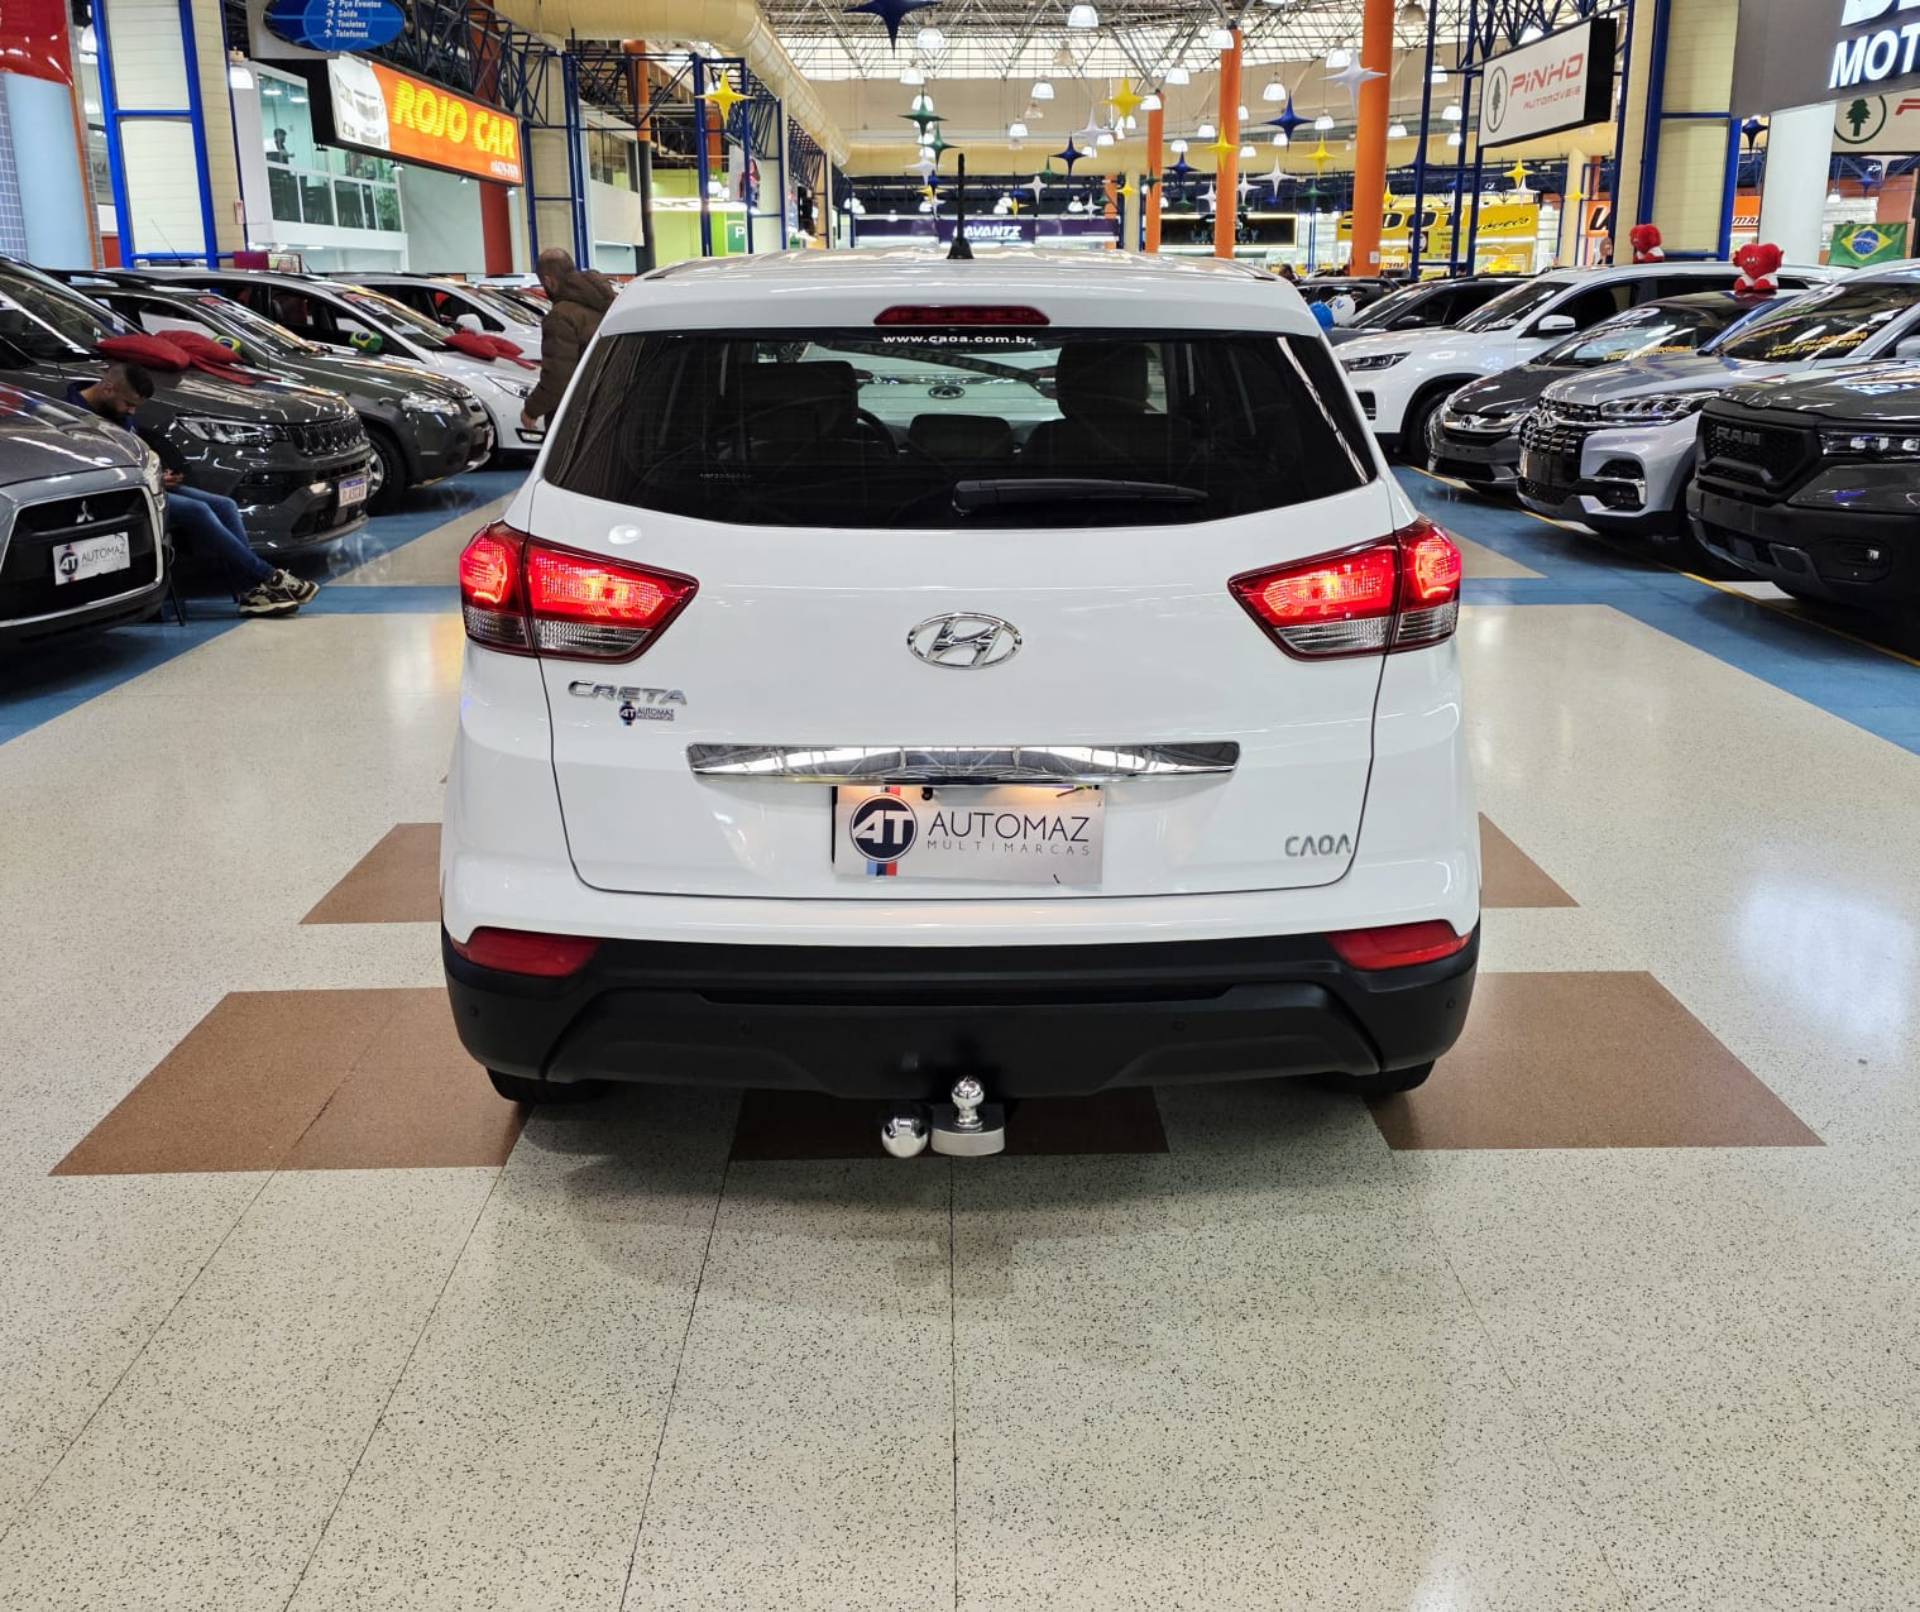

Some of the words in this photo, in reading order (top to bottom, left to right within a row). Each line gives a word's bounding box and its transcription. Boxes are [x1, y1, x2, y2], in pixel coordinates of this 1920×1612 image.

[336, 29, 369, 38] Telefones
[392, 79, 468, 144] ROJO
[472, 110, 515, 159] CAR
[882, 335, 1035, 345] www.caoa.com.br
[1716, 426, 1760, 446] RAM
[568, 680, 687, 705] CRETA
[927, 810, 1090, 843] AUTOMAZ
[927, 840, 1090, 856] MULTIMARCAS
[1285, 833, 1352, 857] CAOA
